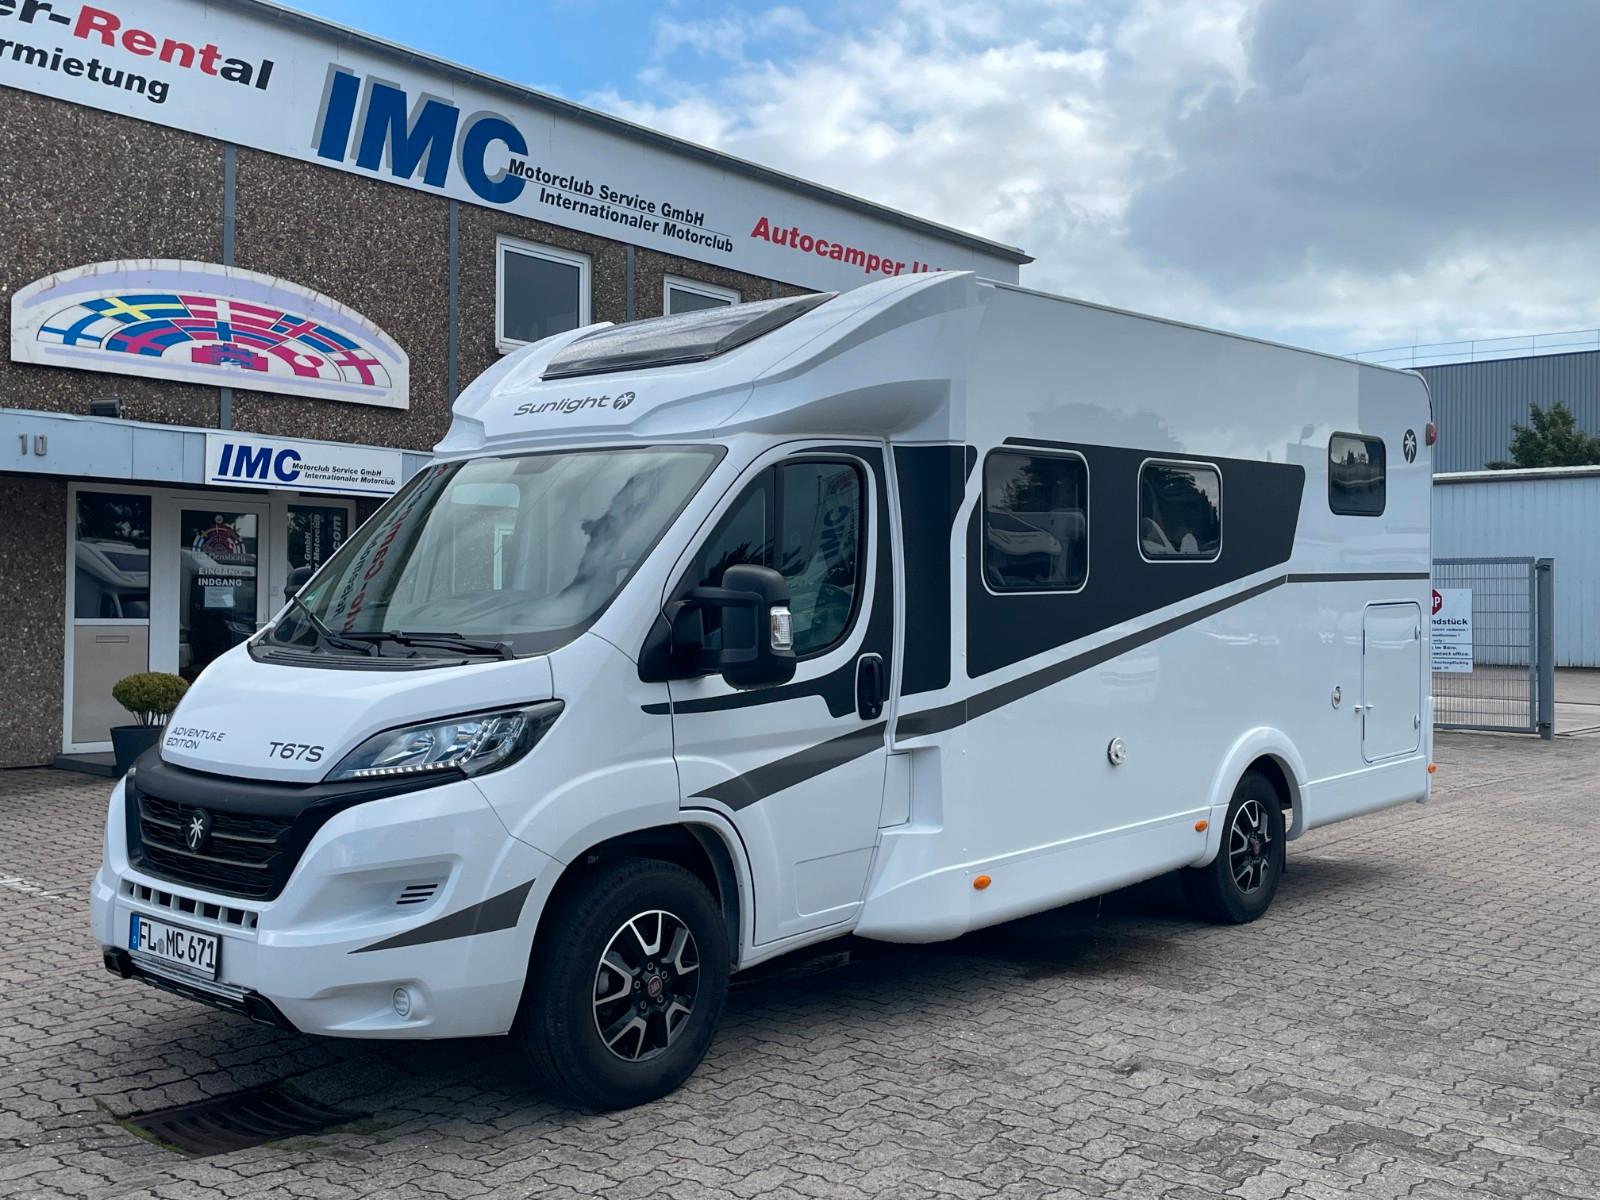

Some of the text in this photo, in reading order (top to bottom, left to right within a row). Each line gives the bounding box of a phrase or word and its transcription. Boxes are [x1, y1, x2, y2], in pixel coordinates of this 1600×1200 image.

[314, 68, 529, 204] IMC
[508, 158, 704, 226] Motorclub Service GmbH
[539, 188, 733, 252] Internationaler Motorclub
[750, 217, 905, 276] Autocamper
[18, 432, 48, 457] 10
[218, 444, 302, 482] IMC
[292, 462, 382, 477] Motorclub Service GmbH
[304, 471, 396, 486] Internationaler Motorclub
[198, 578, 242, 587] INDGANG
[199, 567, 242, 576] EINGANG
[166, 737, 200, 750] EDITION
[171, 727, 226, 742] ADVENTURE
[269, 741, 324, 763] T67S
[139, 921, 156, 951] FL
[166, 928, 184, 959] MC
[188, 935, 215, 969] 671
